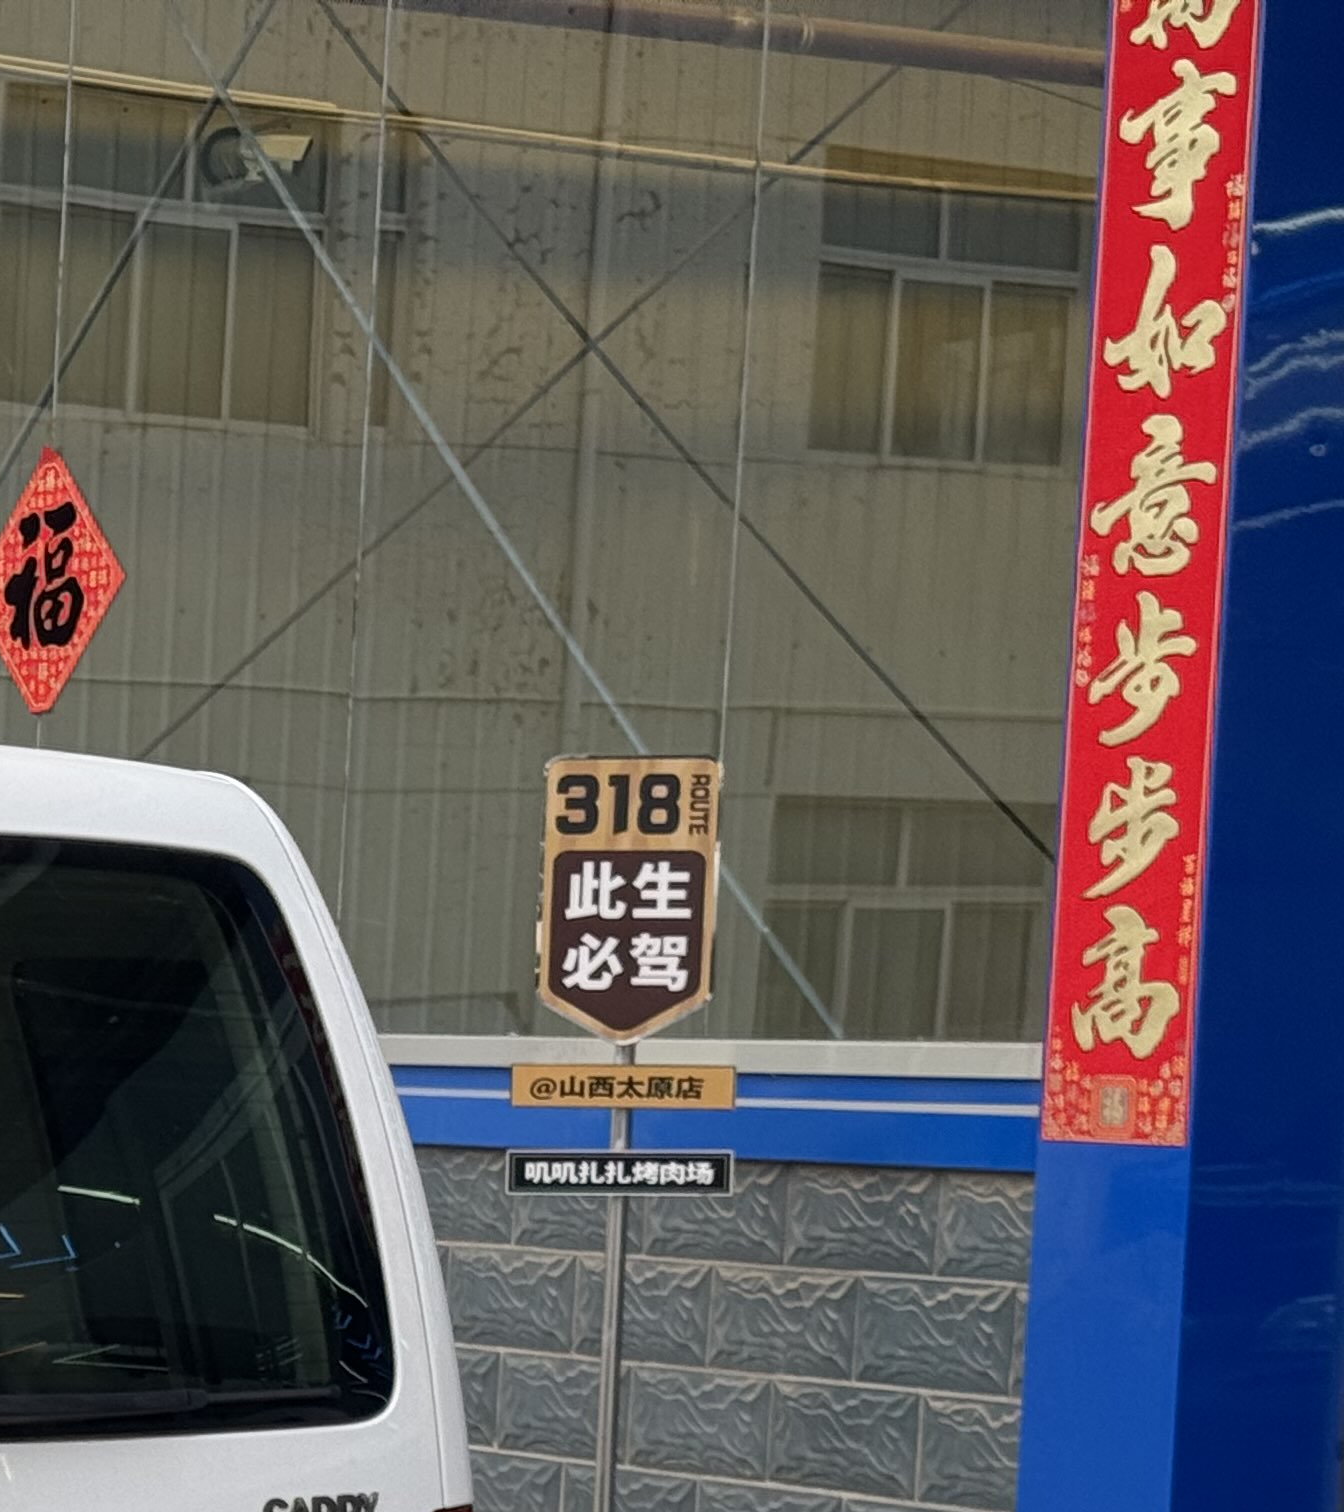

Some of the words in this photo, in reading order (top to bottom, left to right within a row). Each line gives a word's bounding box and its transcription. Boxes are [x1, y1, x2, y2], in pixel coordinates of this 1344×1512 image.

[4, 501, 84, 651] 福
[555, 773, 681, 835] 318
[688, 774, 711, 836] ROUTE
[564, 861, 692, 920] 此生
[562, 932, 690, 992] 必驾
[530, 1075, 705, 1100] @山西太原店
